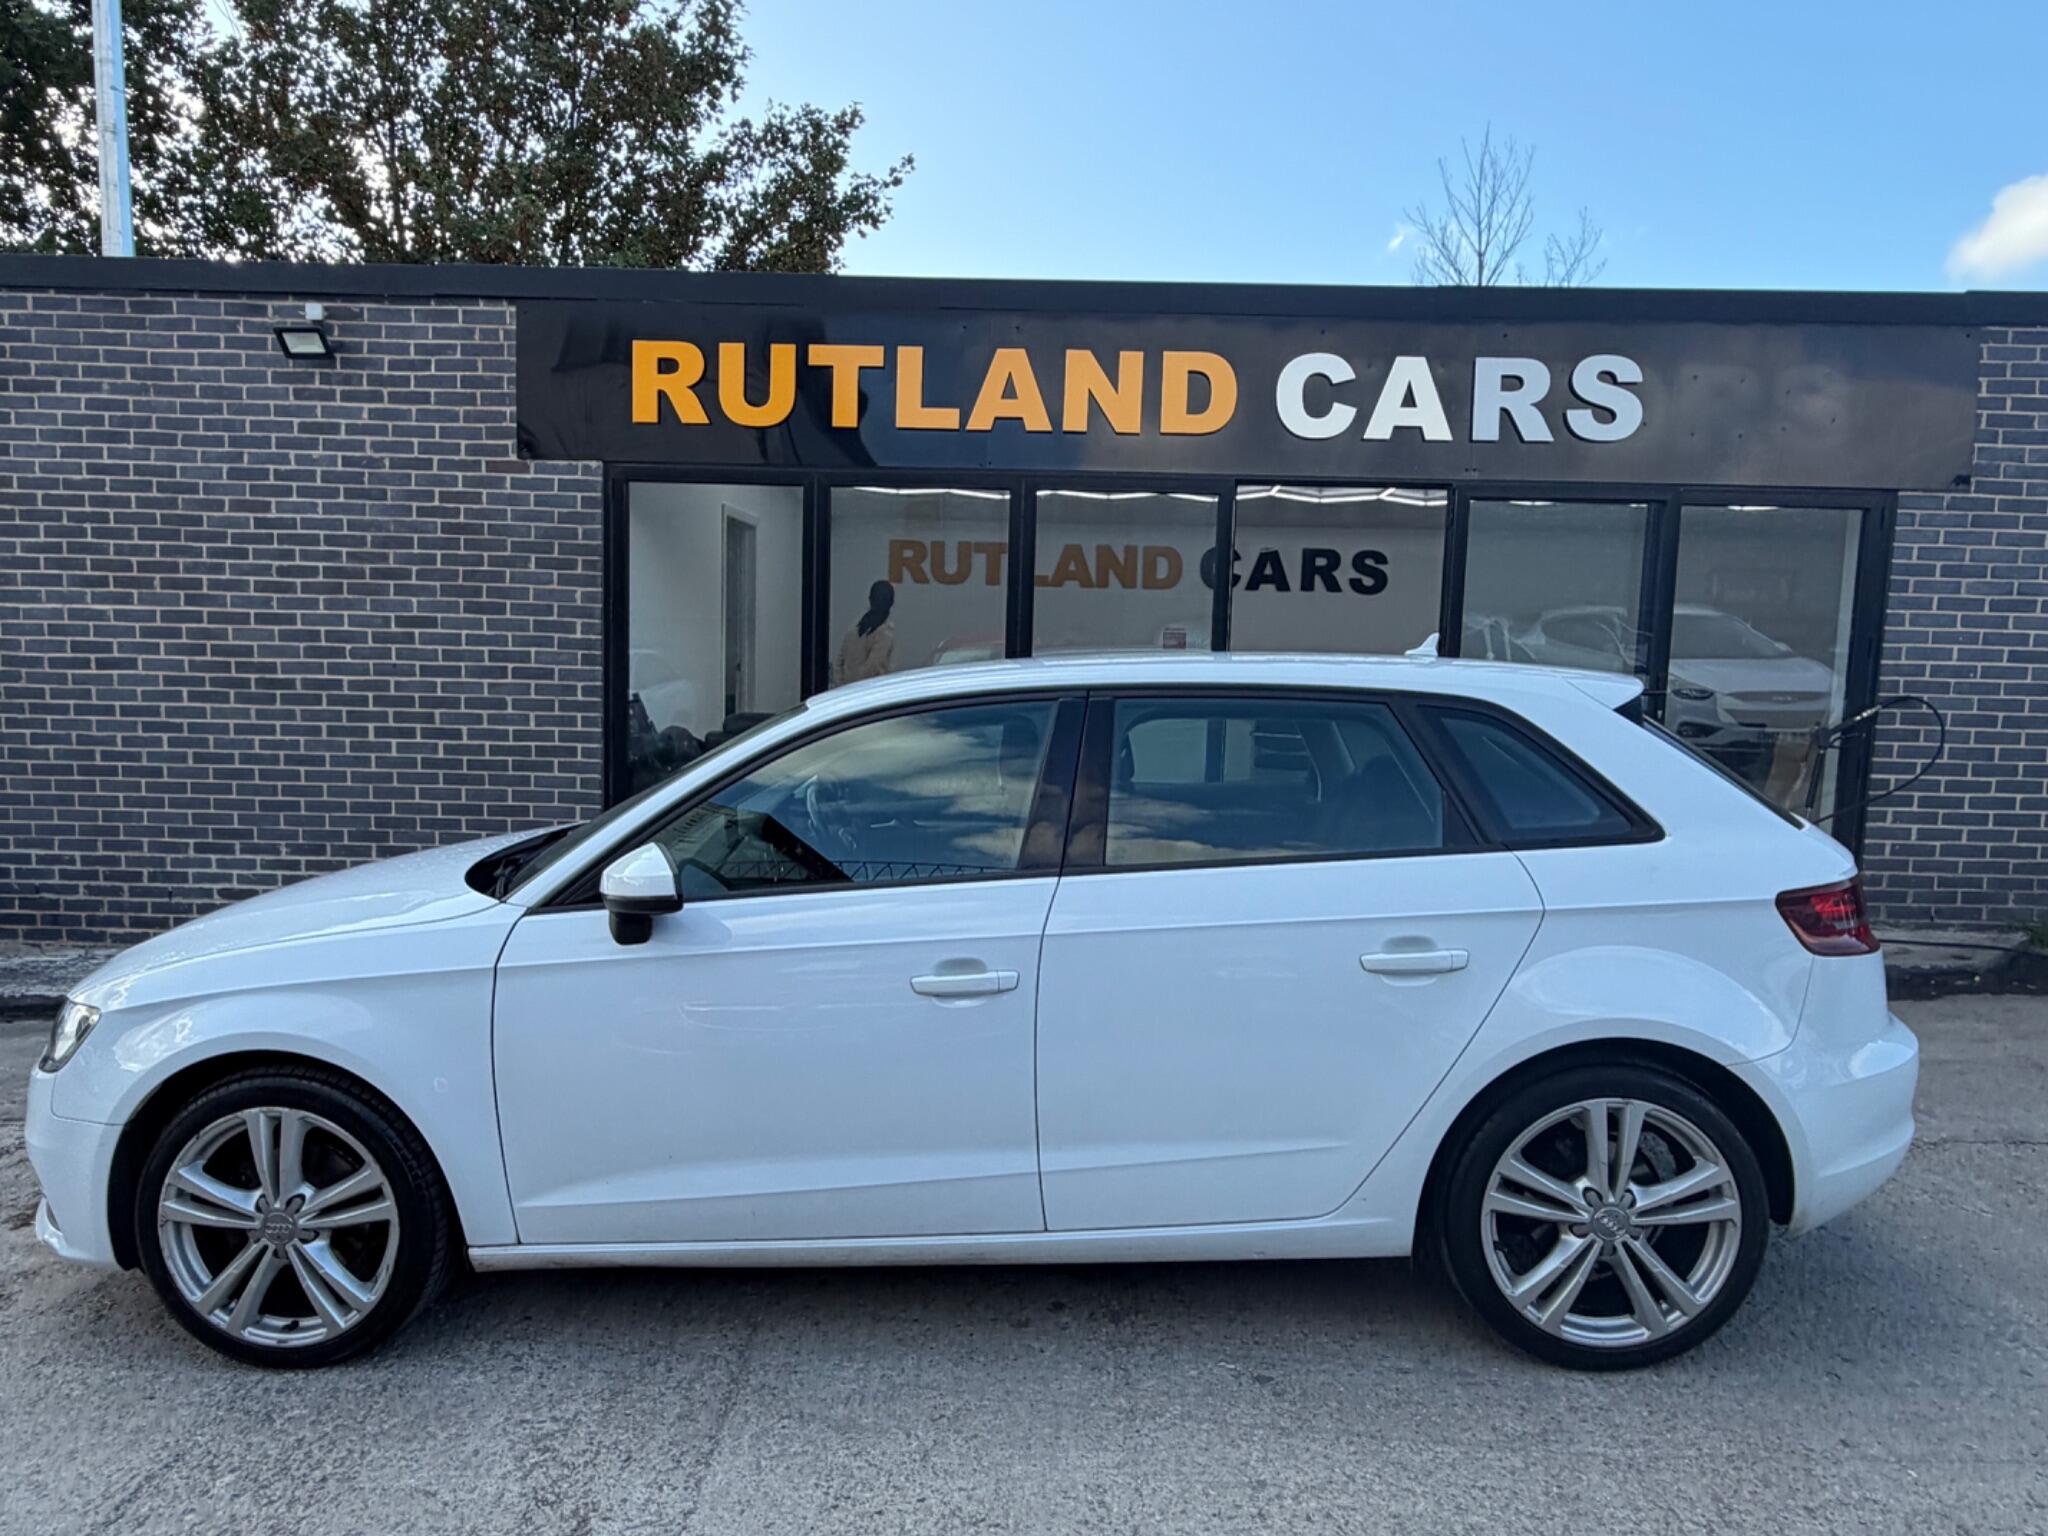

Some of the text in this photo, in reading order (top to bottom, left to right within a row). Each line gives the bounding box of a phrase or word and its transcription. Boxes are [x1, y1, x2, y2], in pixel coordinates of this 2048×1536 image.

[632, 340, 1645, 443] RUTLAND CARS
[889, 539, 1389, 596] RUTAND CARS
